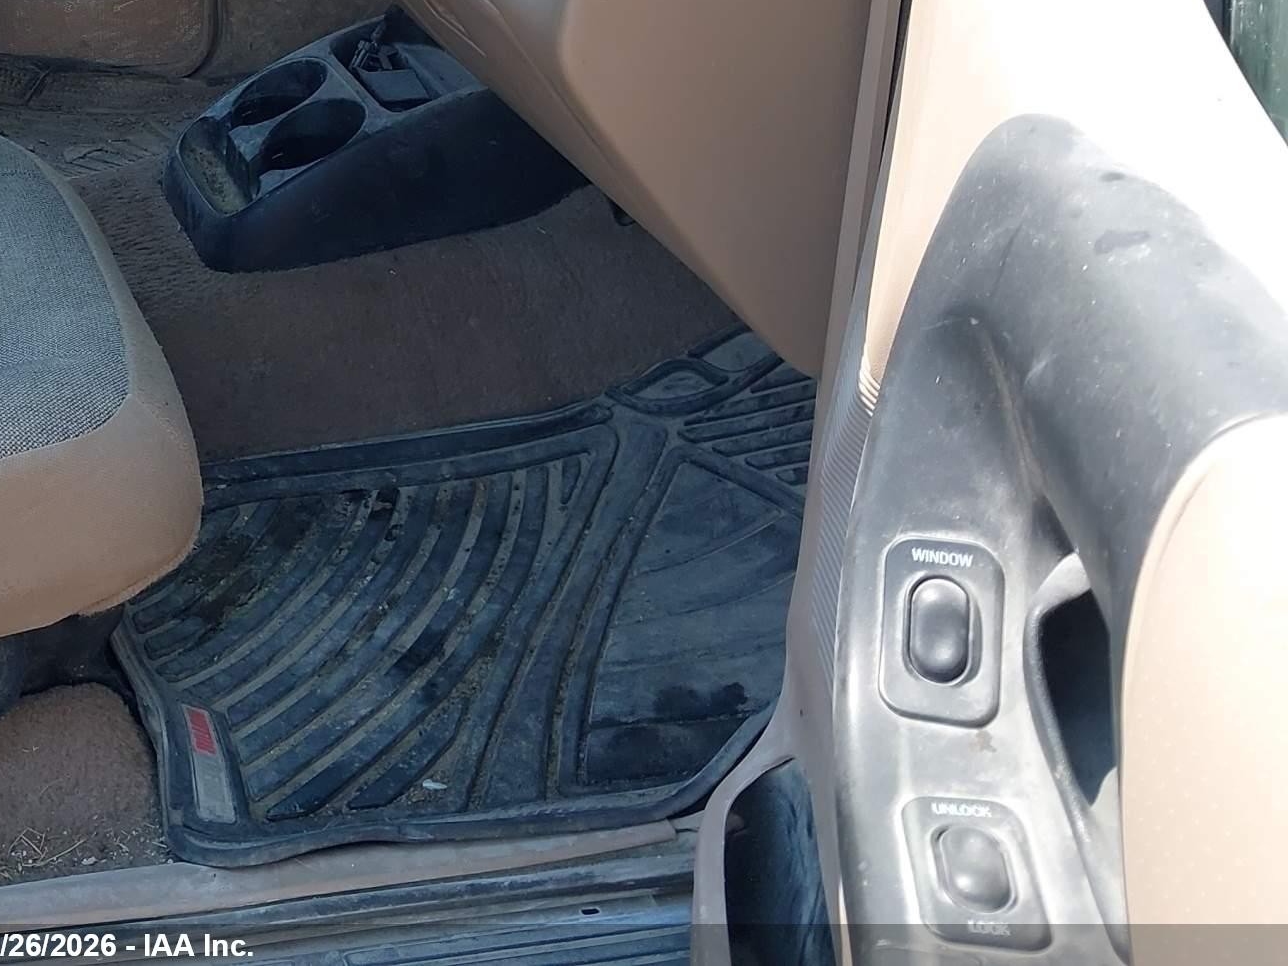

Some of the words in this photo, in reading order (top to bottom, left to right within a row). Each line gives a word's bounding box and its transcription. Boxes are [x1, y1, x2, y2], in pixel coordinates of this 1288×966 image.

[911, 547, 974, 568] WINDOW
[931, 802, 992, 818] UNLOCK
[967, 919, 1011, 936] LOCK
